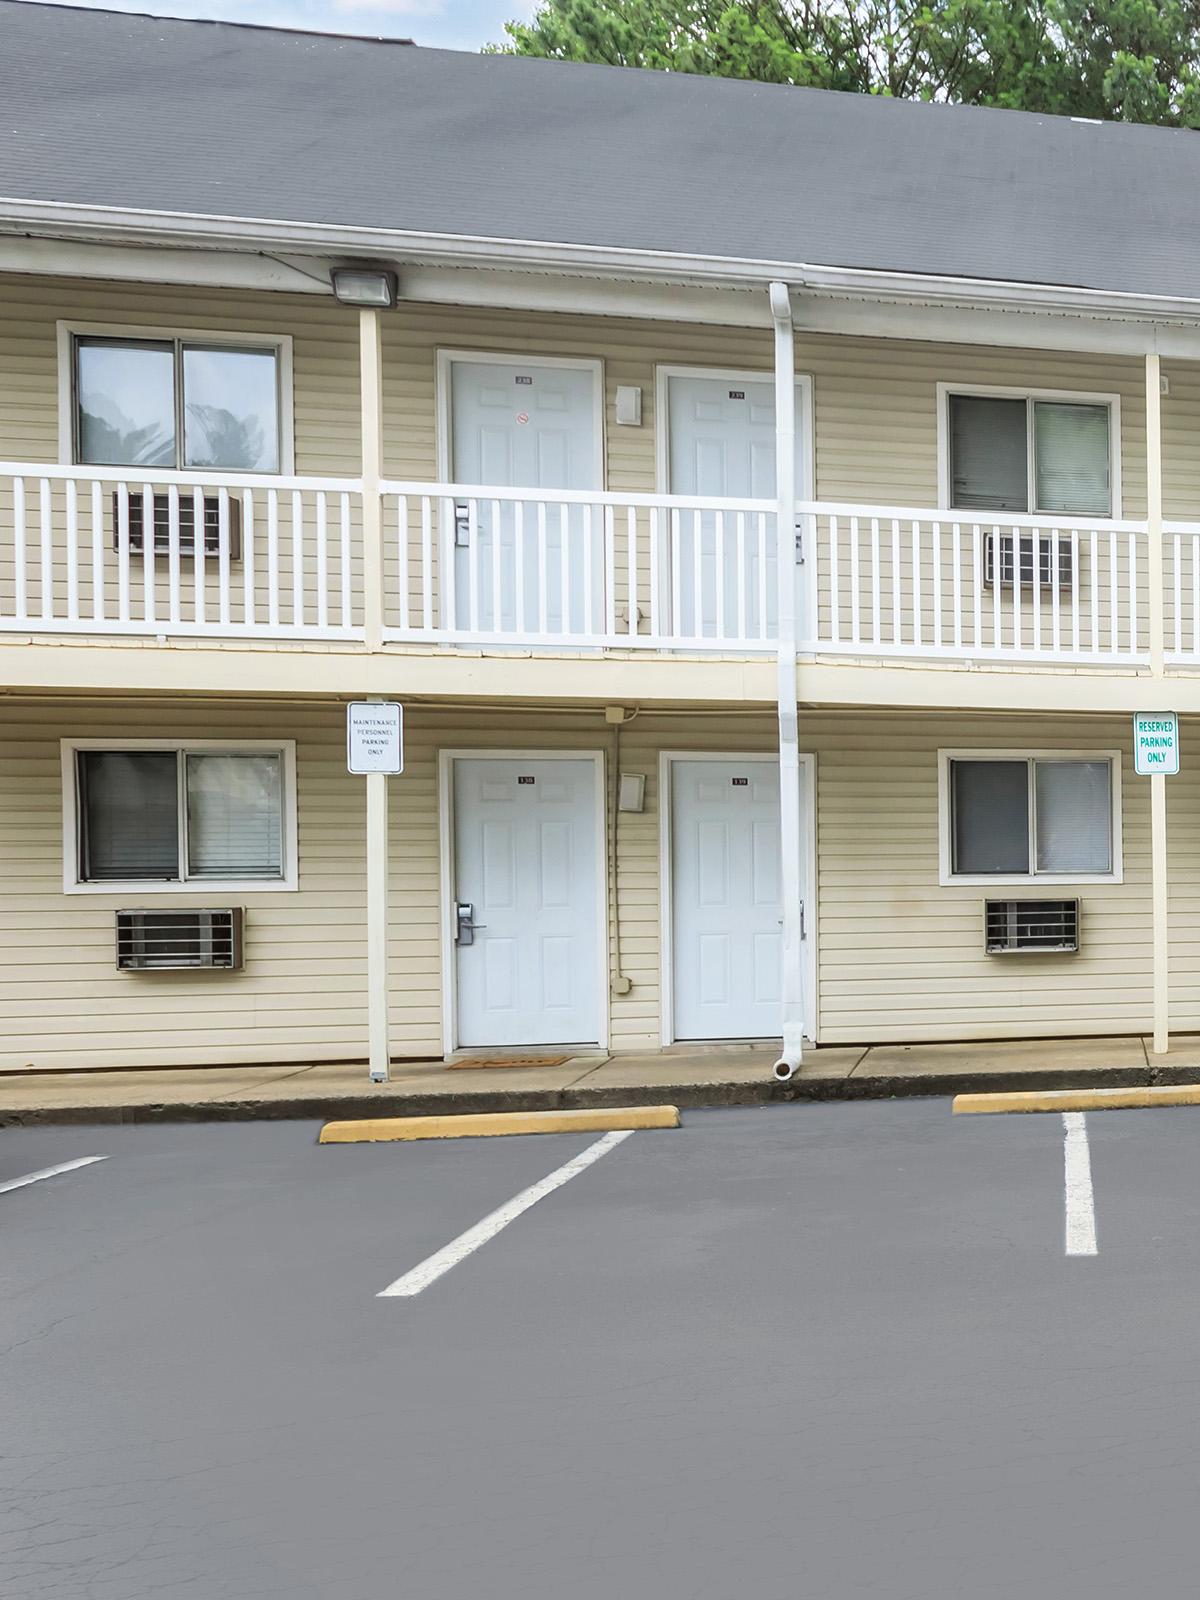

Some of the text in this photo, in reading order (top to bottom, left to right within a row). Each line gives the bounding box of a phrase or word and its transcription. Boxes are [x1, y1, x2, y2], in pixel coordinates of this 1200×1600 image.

[1139, 722, 1173, 732] RESERVED
[1140, 737, 1172, 747] PARKING
[1148, 752, 1166, 762] ONLY
